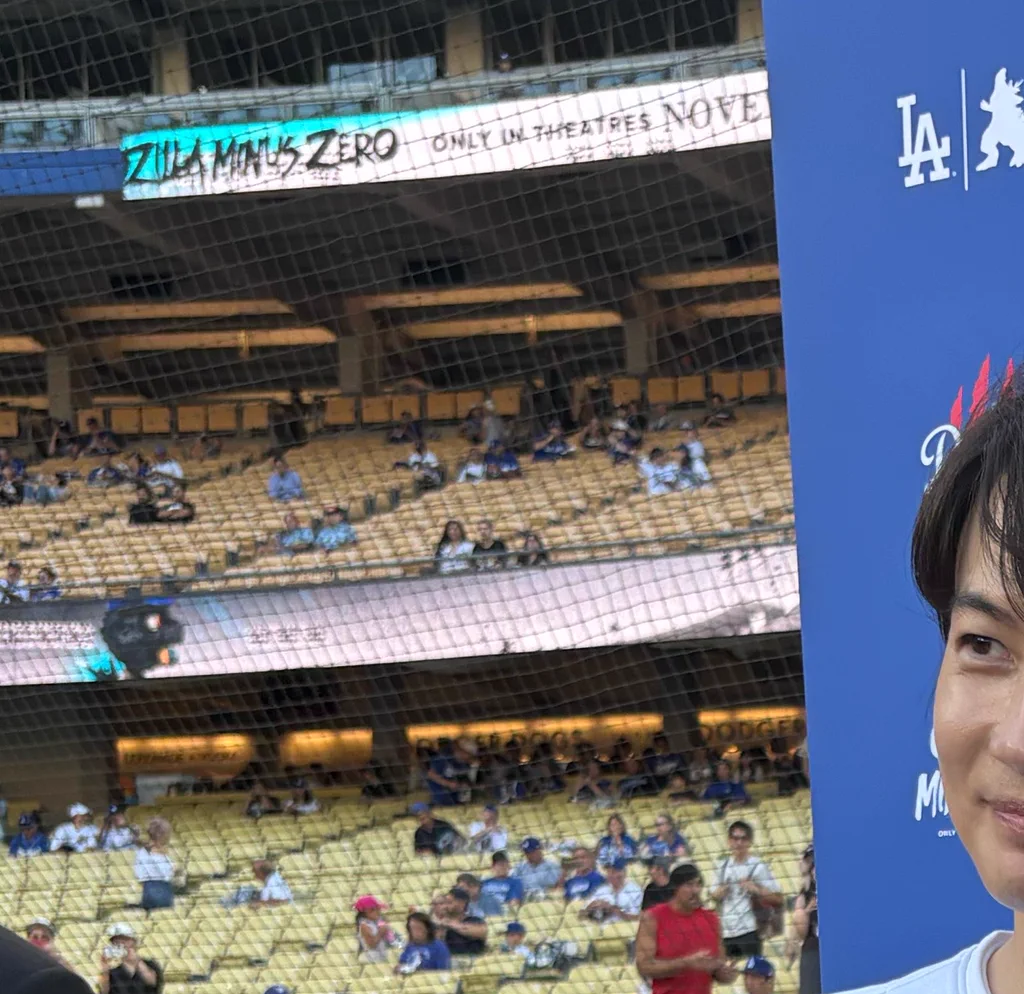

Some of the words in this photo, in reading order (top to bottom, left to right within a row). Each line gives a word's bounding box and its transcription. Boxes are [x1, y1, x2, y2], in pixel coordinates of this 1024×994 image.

[213, 134, 300, 178] MINUS
[306, 128, 398, 169] ZERO
[432, 128, 492, 153] ONLY
[502, 126, 524, 145] IN
[533, 113, 652, 140] THEATRES
[897, 94, 951, 188] LA
